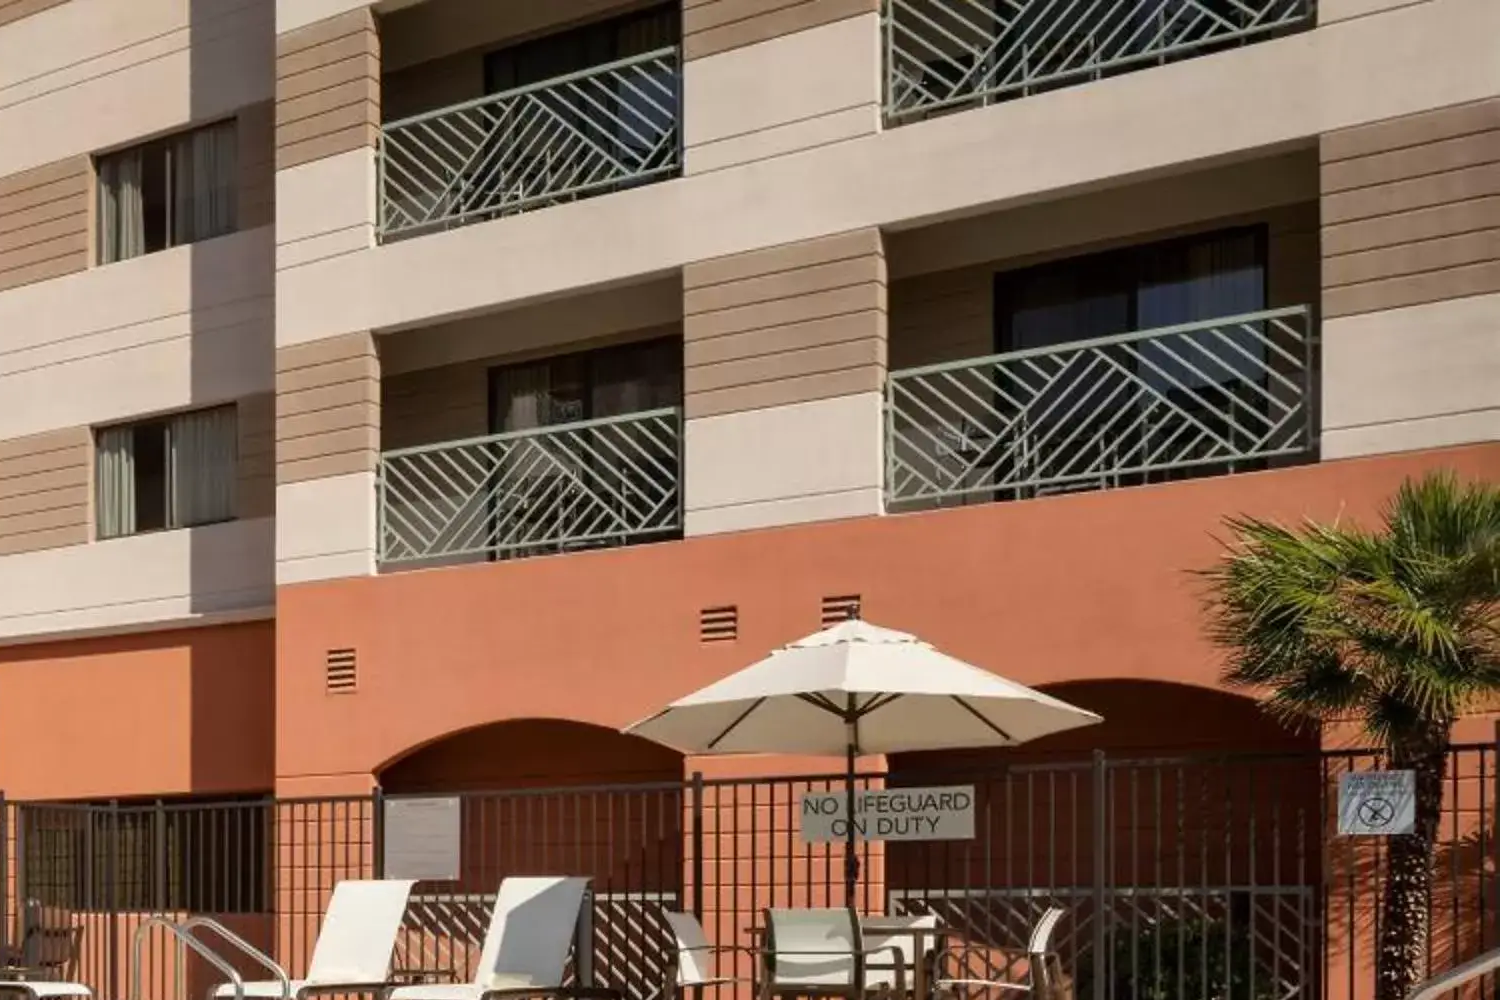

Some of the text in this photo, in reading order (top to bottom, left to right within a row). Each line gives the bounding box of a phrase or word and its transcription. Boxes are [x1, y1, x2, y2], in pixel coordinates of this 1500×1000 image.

[803, 798, 838, 815] NO
[831, 815, 941, 836] ON DUTY
